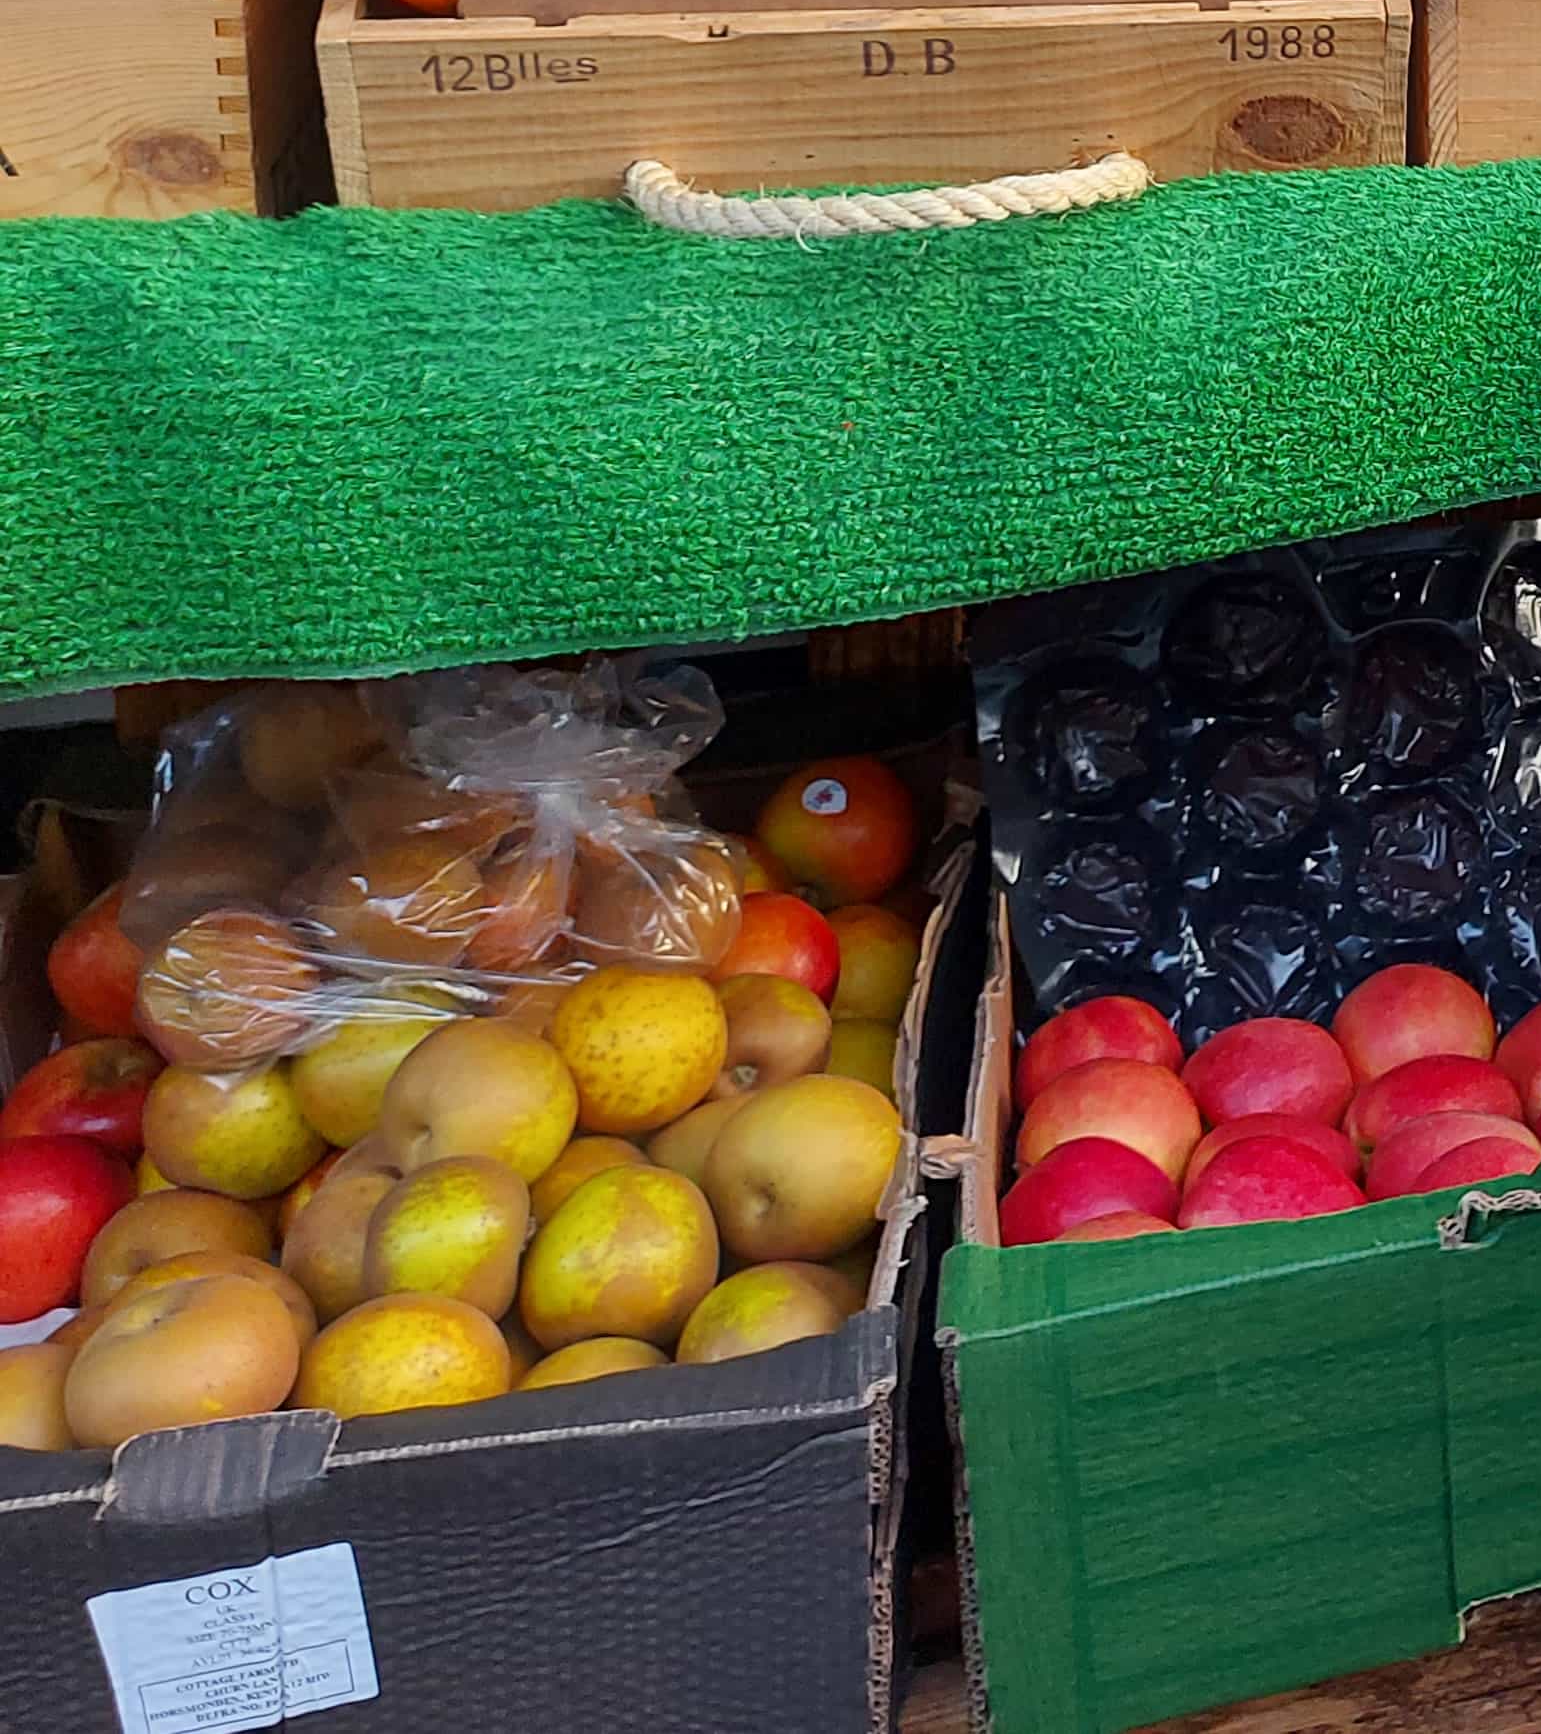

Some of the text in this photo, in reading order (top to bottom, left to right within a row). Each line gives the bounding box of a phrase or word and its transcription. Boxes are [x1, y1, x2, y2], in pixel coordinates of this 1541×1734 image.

[1217, 24, 1336, 62] 1988
[184, 1575, 261, 1606] COX
[203, 1613, 248, 1629] CLASS
[175, 1674, 234, 1694] COTTAGE
[204, 1682, 249, 1699] CHURN
[246, 1686, 279, 1701] KENT
